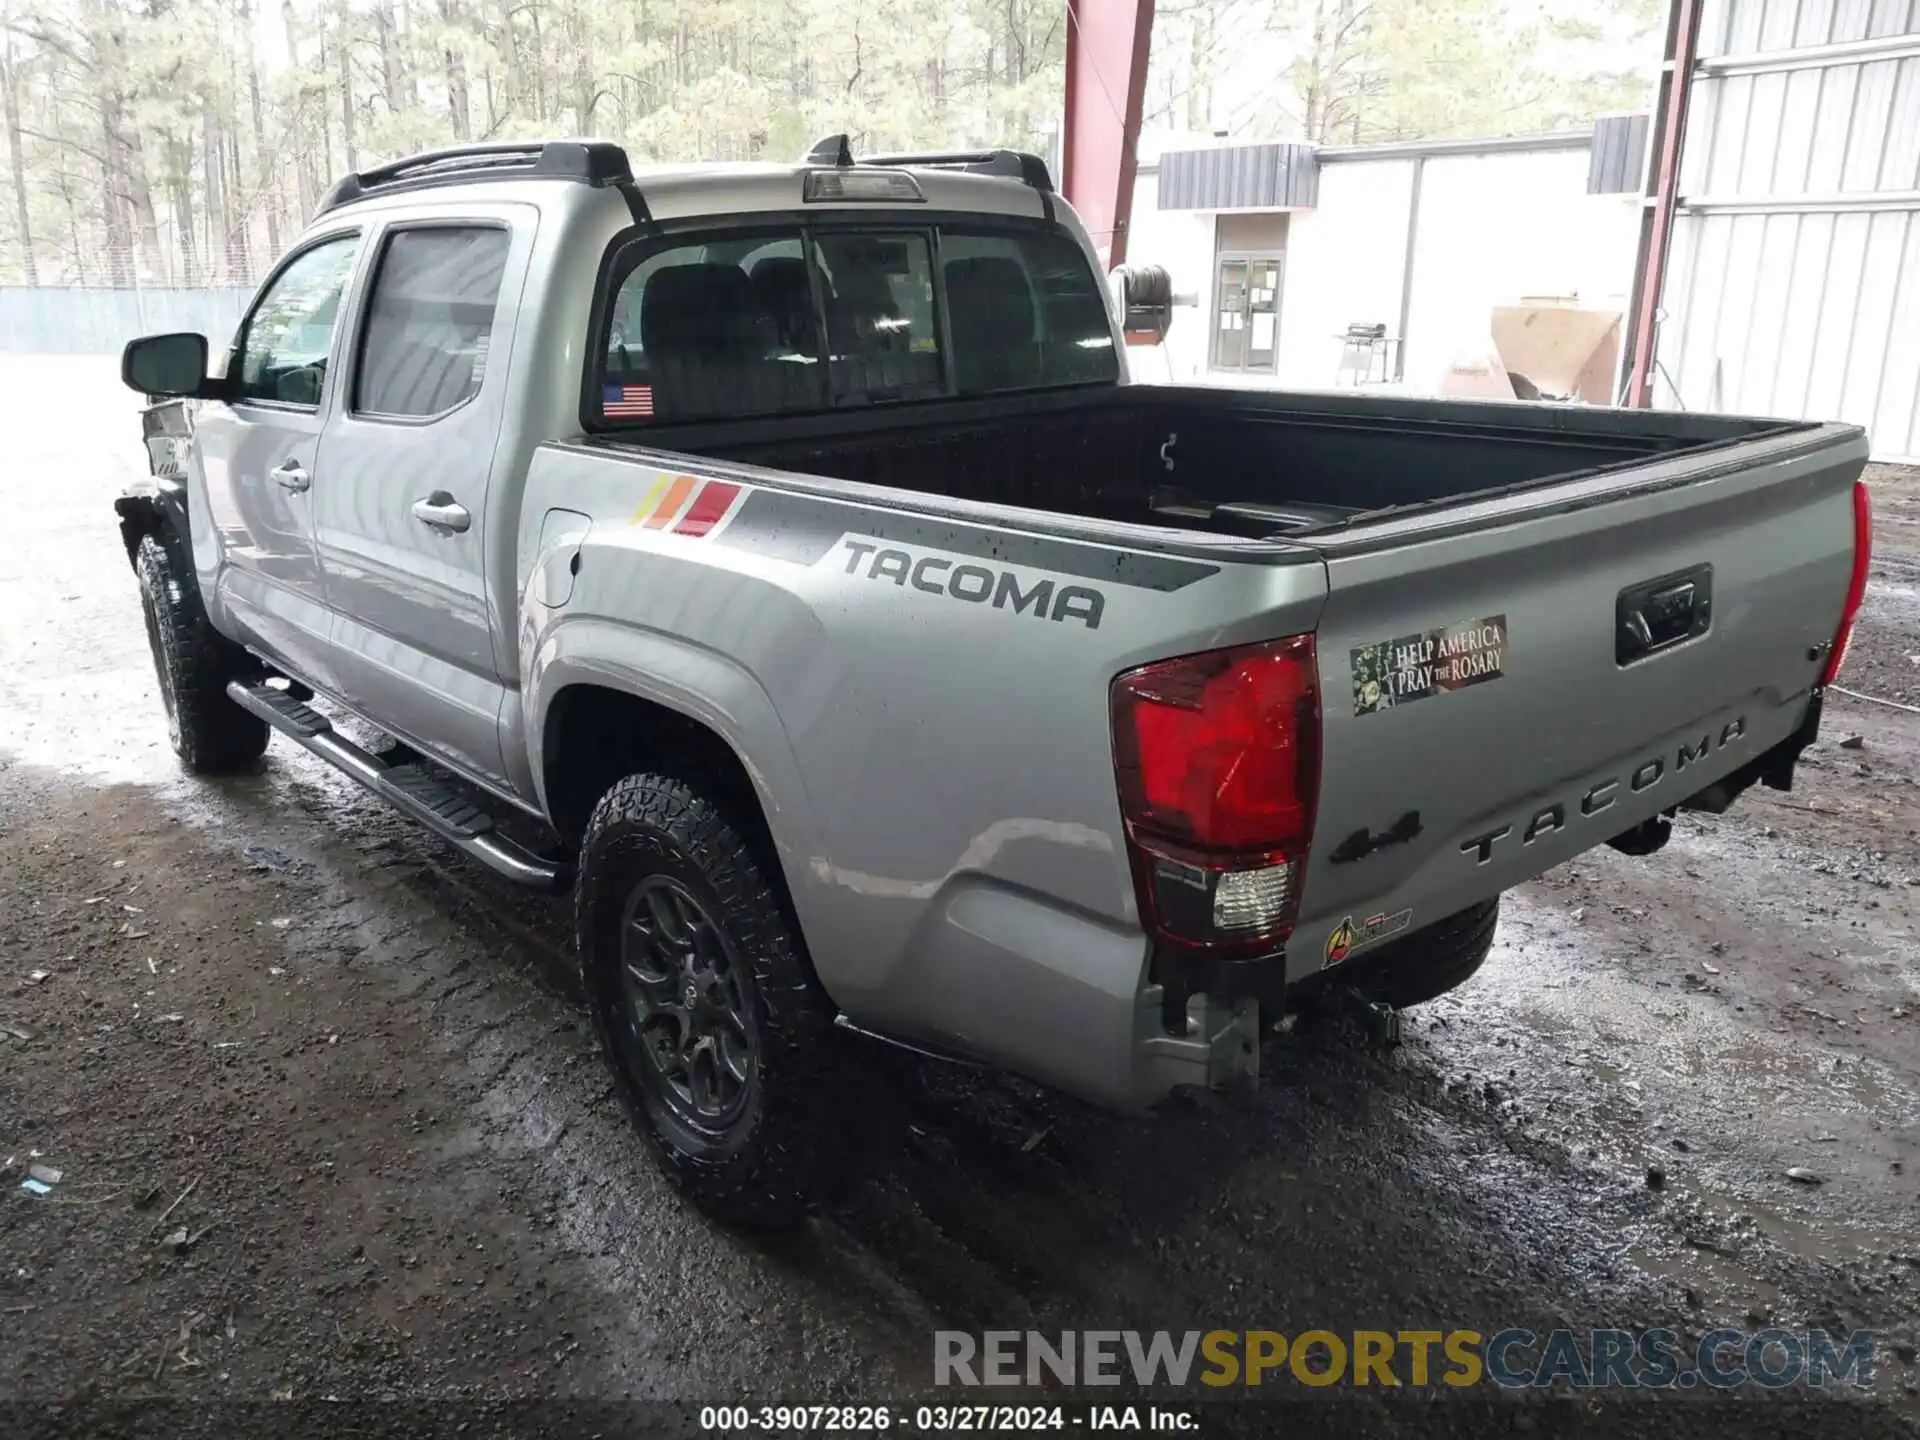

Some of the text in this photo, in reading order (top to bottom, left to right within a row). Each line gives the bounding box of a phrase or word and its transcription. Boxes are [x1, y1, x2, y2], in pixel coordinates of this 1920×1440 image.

[845, 540, 1105, 630] TACOMA
[1396, 623, 1502, 668] HELP AMERICA
[1398, 647, 1503, 695] PRAY THE ROSARY
[1459, 715, 1746, 867] TACOMA
